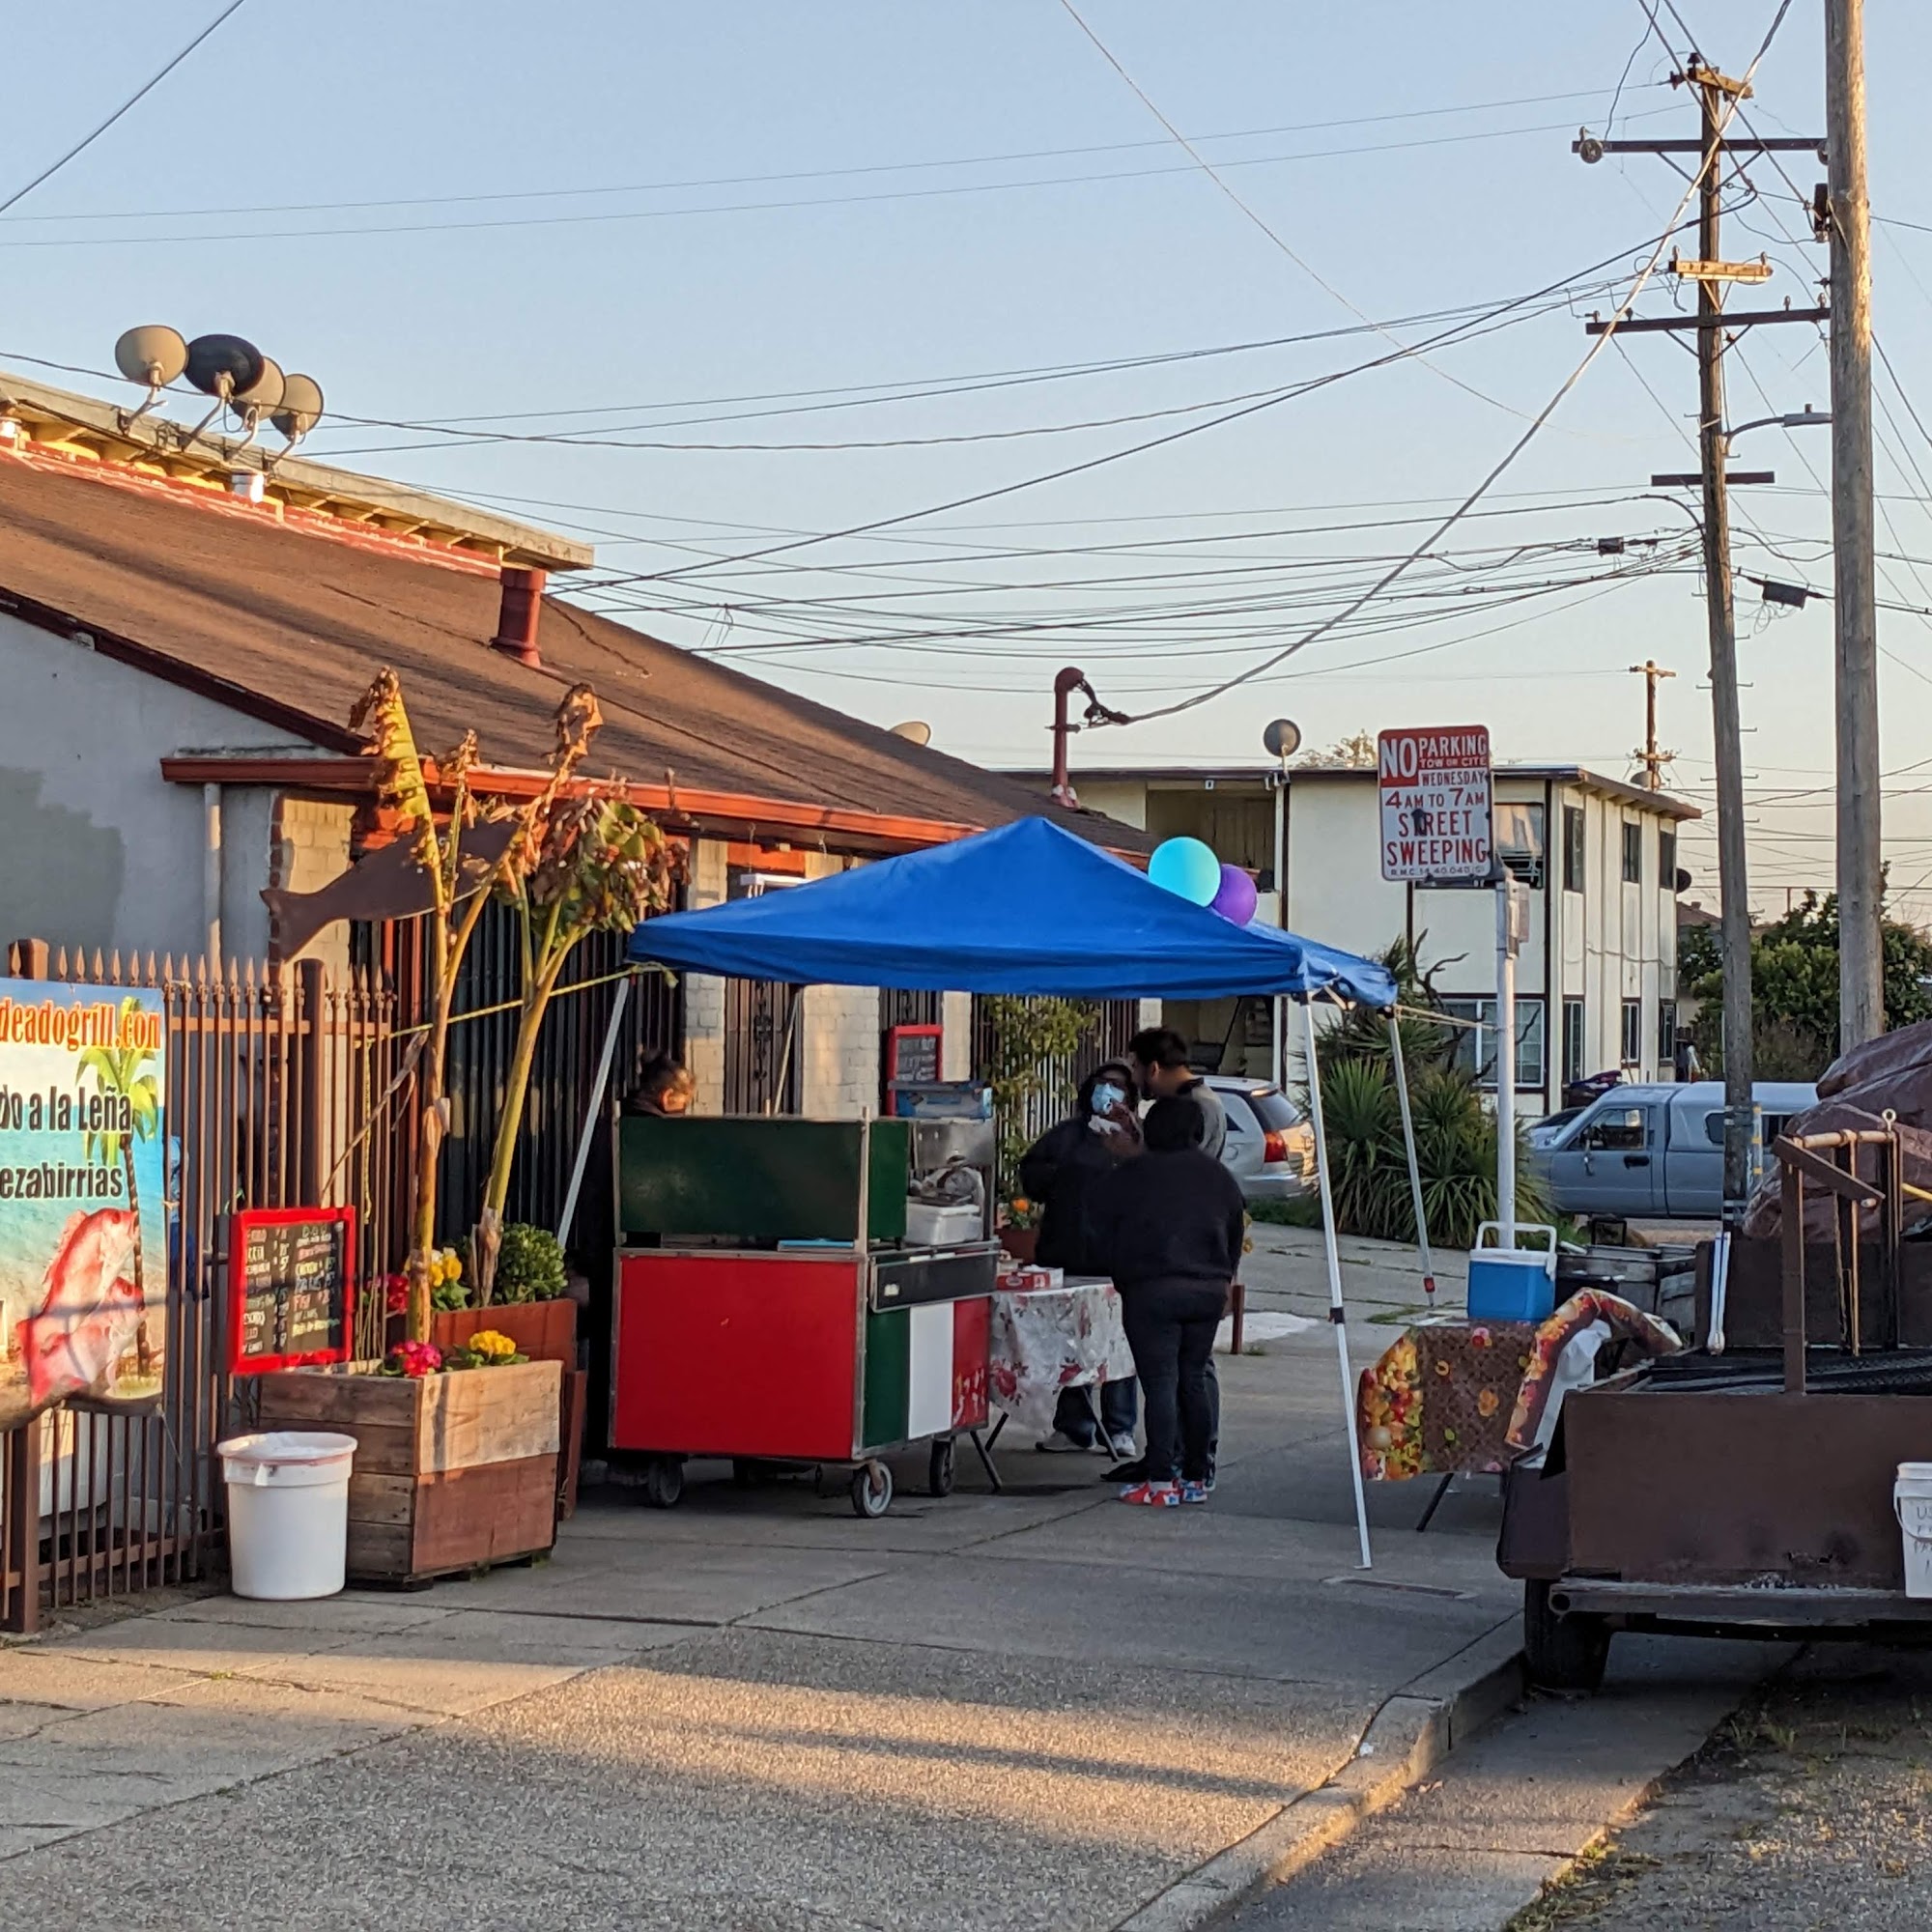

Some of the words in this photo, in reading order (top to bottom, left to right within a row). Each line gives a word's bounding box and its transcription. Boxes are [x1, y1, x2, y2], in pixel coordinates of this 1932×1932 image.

[1380, 738, 1417, 779] NO
[1419, 734, 1487, 757] PARKING
[1419, 758, 1444, 768] TOW
[1461, 756, 1487, 767] CITE
[1422, 771, 1485, 786] WEDNESDAY
[1428, 794, 1444, 808] TO
[1386, 838, 1488, 867] SWEEPING
[29, 1093, 43, 1131] a
[49, 1086, 71, 1131] la
[78, 1085, 131, 1131] Leña
[0, 1162, 123, 1199] ezabirrias
